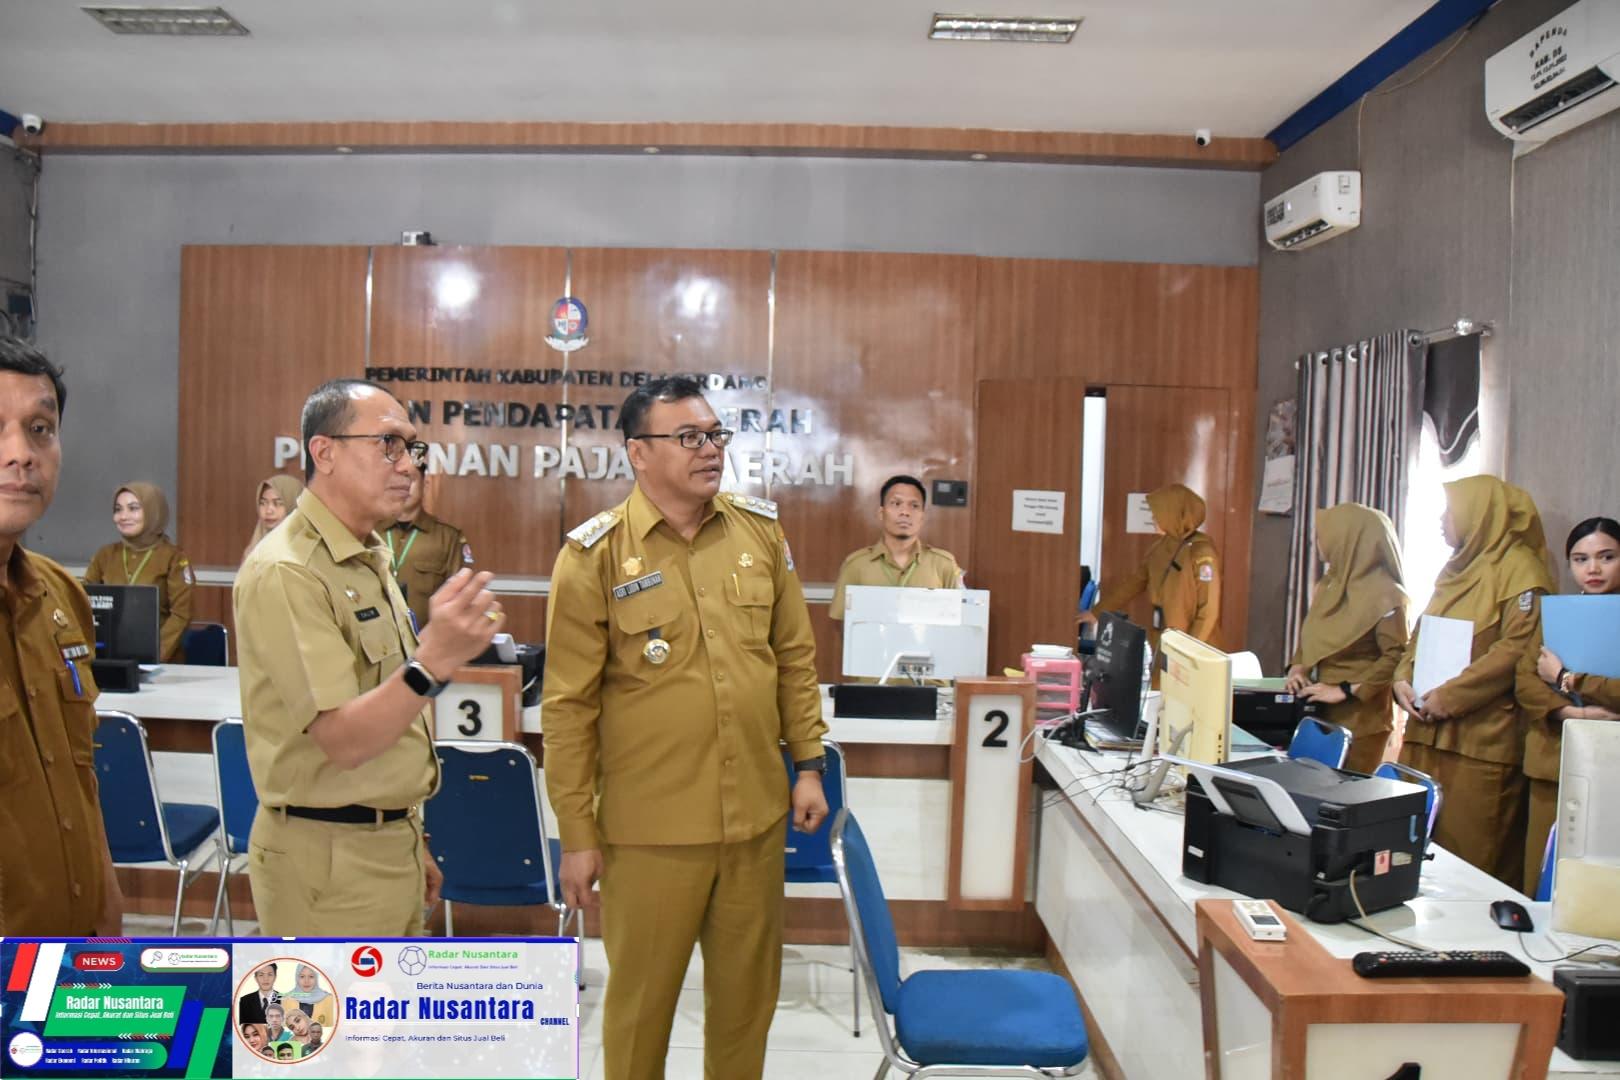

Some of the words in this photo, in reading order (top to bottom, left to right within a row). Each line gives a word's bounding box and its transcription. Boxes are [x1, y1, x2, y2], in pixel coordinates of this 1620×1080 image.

[365, 367, 491, 384] PEMERINTAH
[497, 369, 613, 386] KABUPATEN
[443, 401, 626, 429] PENDAPAT
[720, 407, 812, 433] ERAH
[534, 445, 636, 481] PAJA
[457, 699, 483, 737] 3
[981, 709, 1010, 748] 2
